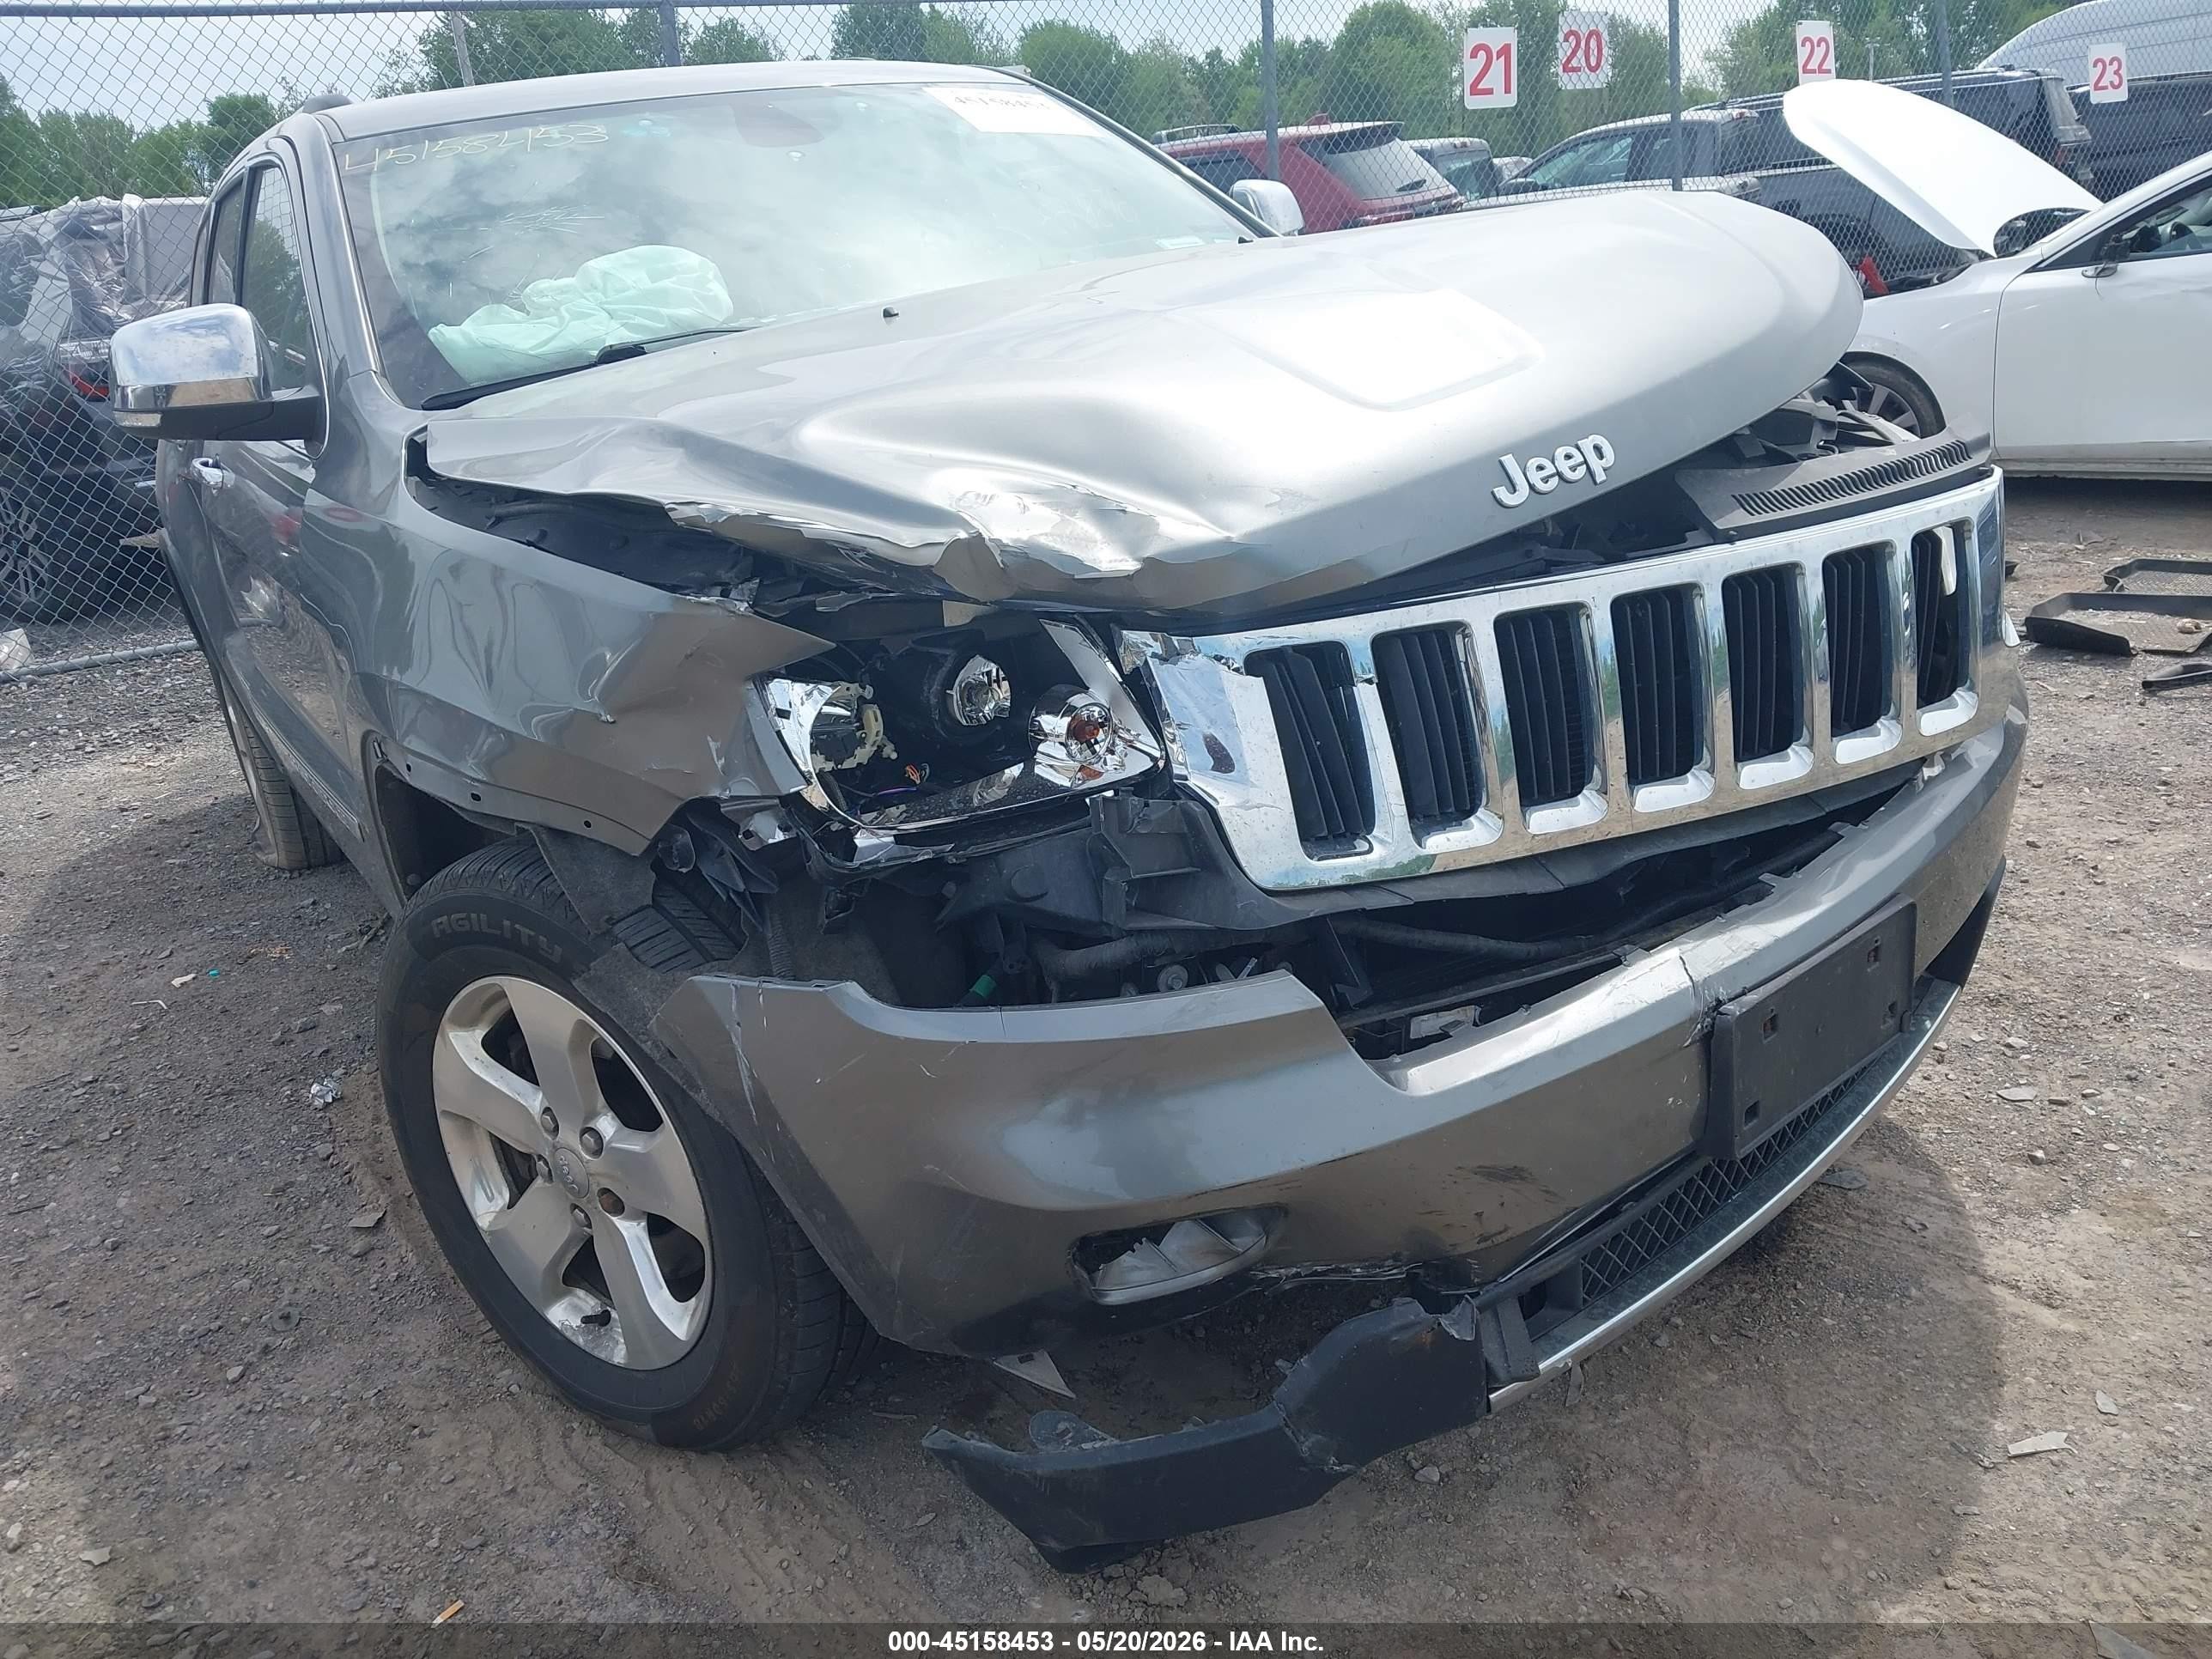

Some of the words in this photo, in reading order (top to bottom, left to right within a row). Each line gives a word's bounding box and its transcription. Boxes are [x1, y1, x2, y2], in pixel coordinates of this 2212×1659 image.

[1469, 43, 1512, 96] 21
[1562, 28, 1603, 73] 20
[1801, 36, 1832, 74] 22
[2093, 56, 2124, 92] 23
[345, 125, 609, 172] 45158453
[1491, 434, 1615, 508] Jeep
[431, 913, 562, 963] AGILITY
